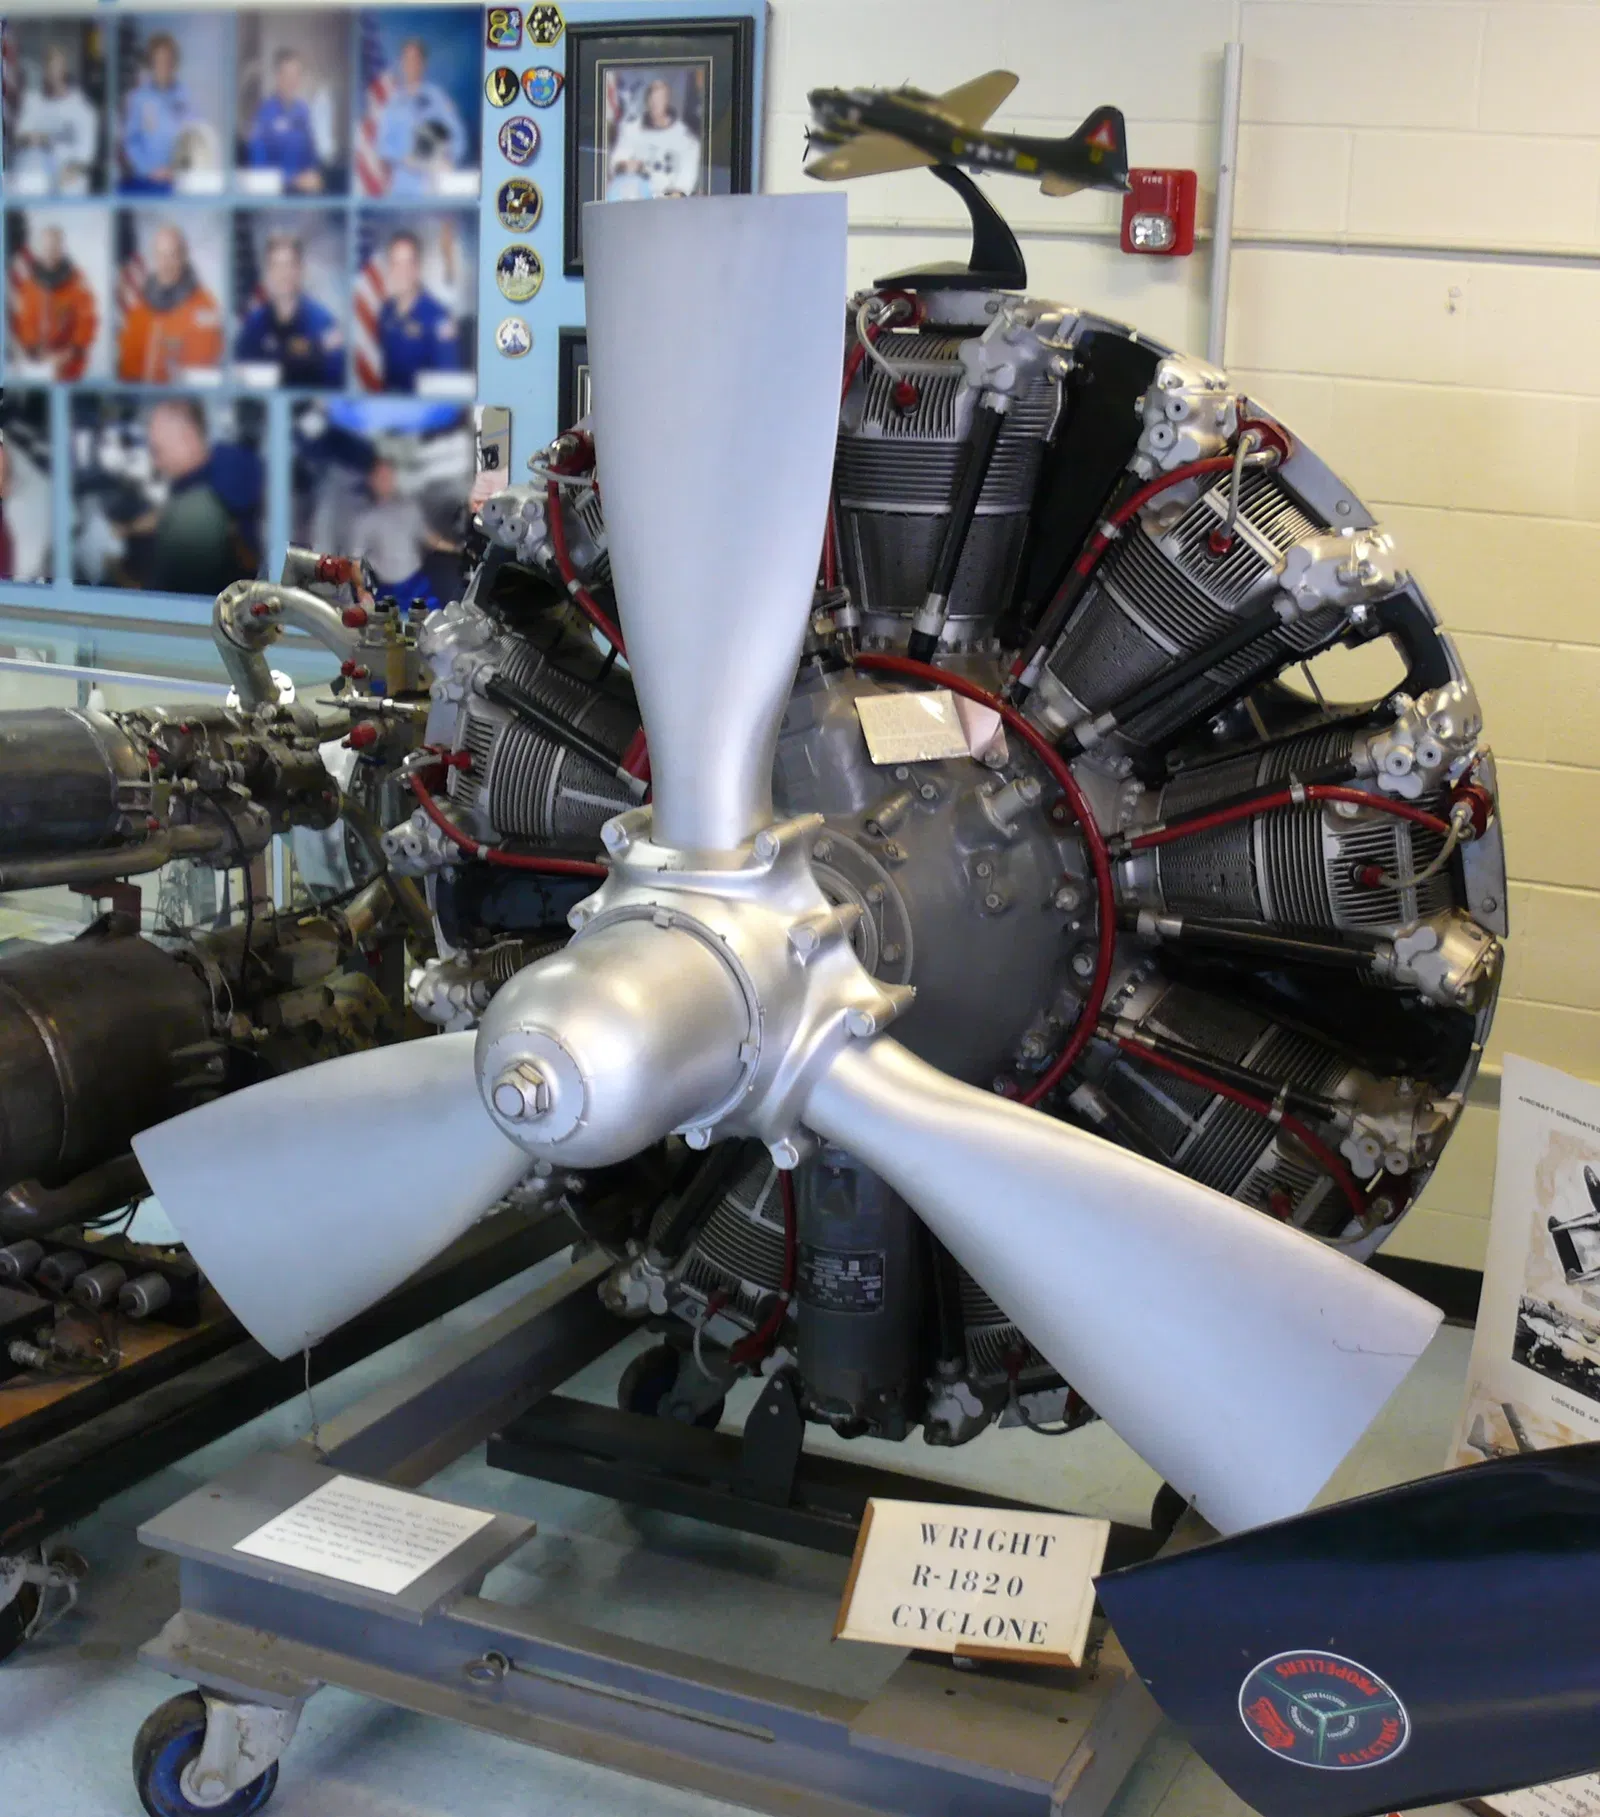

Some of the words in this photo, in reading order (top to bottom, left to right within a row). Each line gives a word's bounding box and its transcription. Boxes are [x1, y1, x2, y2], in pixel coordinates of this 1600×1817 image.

[1142, 175, 1163, 184] FIRE
[920, 1523, 1056, 1558] WRIGHT
[912, 1564, 1024, 1597] R-1820
[892, 1604, 1048, 1645] CYCLONE
[1275, 1658, 1380, 1696] PROPELLERS
[1338, 1717, 1399, 1764] ELECTRIC
